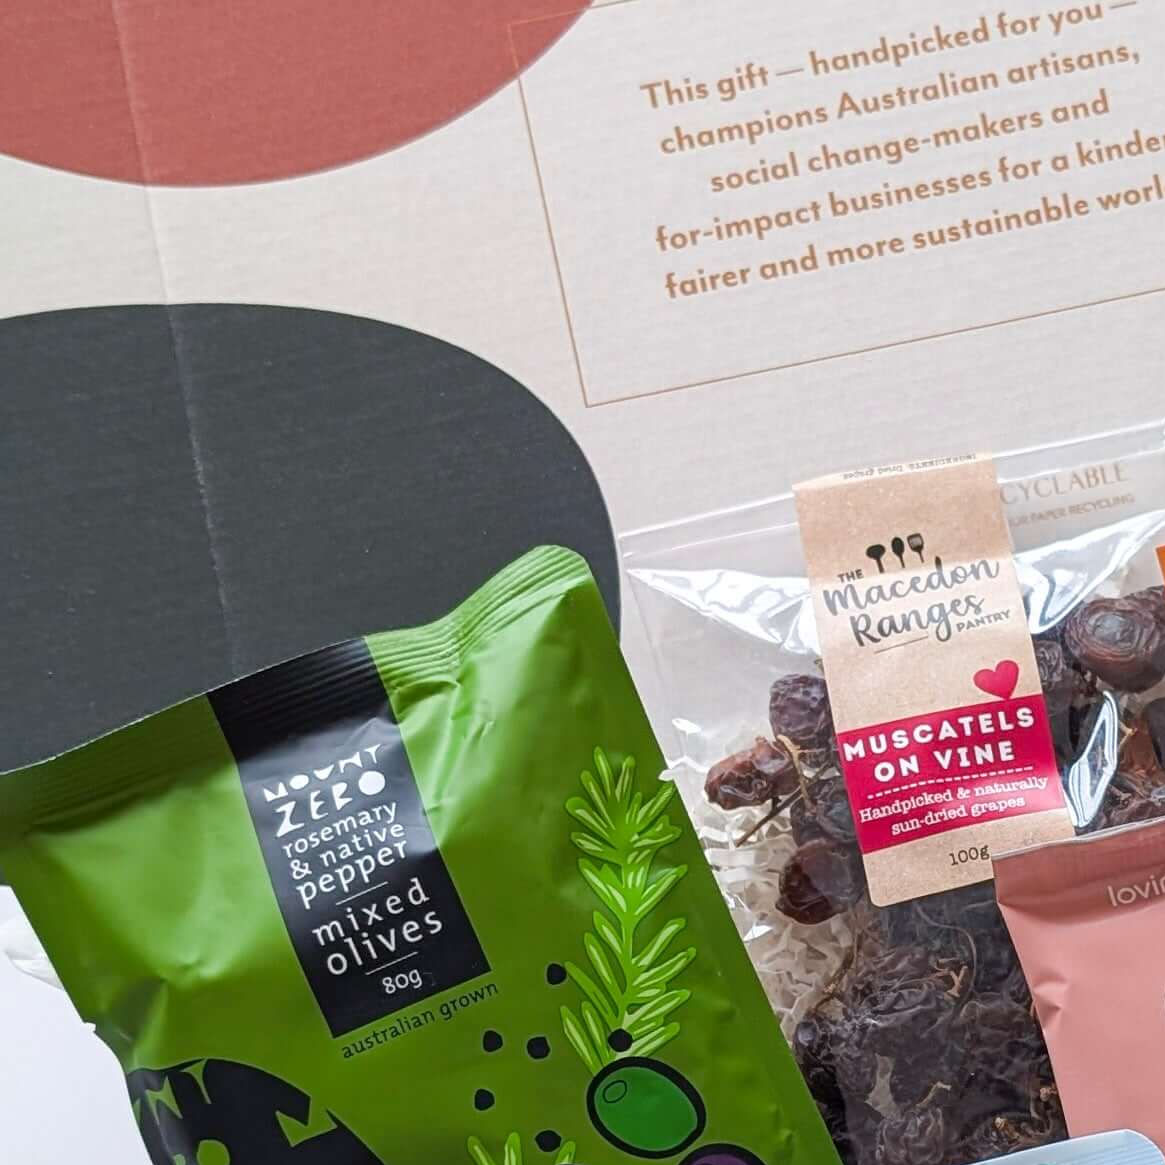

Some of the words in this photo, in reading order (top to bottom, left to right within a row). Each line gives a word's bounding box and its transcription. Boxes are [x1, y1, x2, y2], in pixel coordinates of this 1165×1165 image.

[640, 82, 708, 109] This
[717, 63, 769, 101] gift
[810, 18, 990, 75] handpicked
[997, 13, 1040, 38] for
[1048, 4, 1101, 36] you
[660, 105, 828, 154] champions
[837, 71, 999, 117] Australian
[1007, 42, 1140, 84] artisans,
[711, 151, 798, 192] social
[808, 109, 1043, 173] change-makers
[1051, 89, 1110, 125] and
[656, 201, 822, 252] for-impact
[830, 165, 992, 217] businesses
[998, 158, 1042, 183] for
[1050, 155, 1069, 172] a
[665, 266, 750, 299] fairer
[760, 245, 818, 280] and
[827, 234, 905, 266] more
[913, 193, 1089, 249] sustainable
[822, 556, 999, 616] Macedon
[837, 569, 863, 583] THE
[850, 593, 985, 646] Ranges
[956, 610, 1011, 632] PANTRY
[843, 708, 1034, 761] MUSCATELS
[874, 755, 919, 782] ON
[933, 741, 1014, 769] VINE
[263, 744, 380, 802] MOUNT
[859, 791, 953, 823] Handpicked
[957, 788, 970, 799] &
[975, 776, 1048, 796] naturally
[276, 771, 385, 838] ZERO
[283, 802, 396, 857] rosemary
[892, 805, 967, 835] sun-dried
[971, 796, 1025, 816] grapes
[290, 860, 312, 880] &
[320, 823, 405, 866] native
[296, 840, 407, 909] pepper
[949, 845, 990, 866] 100g
[312, 877, 430, 946] mixed
[328, 911, 442, 975] olives
[382, 969, 422, 994] 80g
[342, 1010, 435, 1058] australian
[439, 981, 498, 1020] grown
